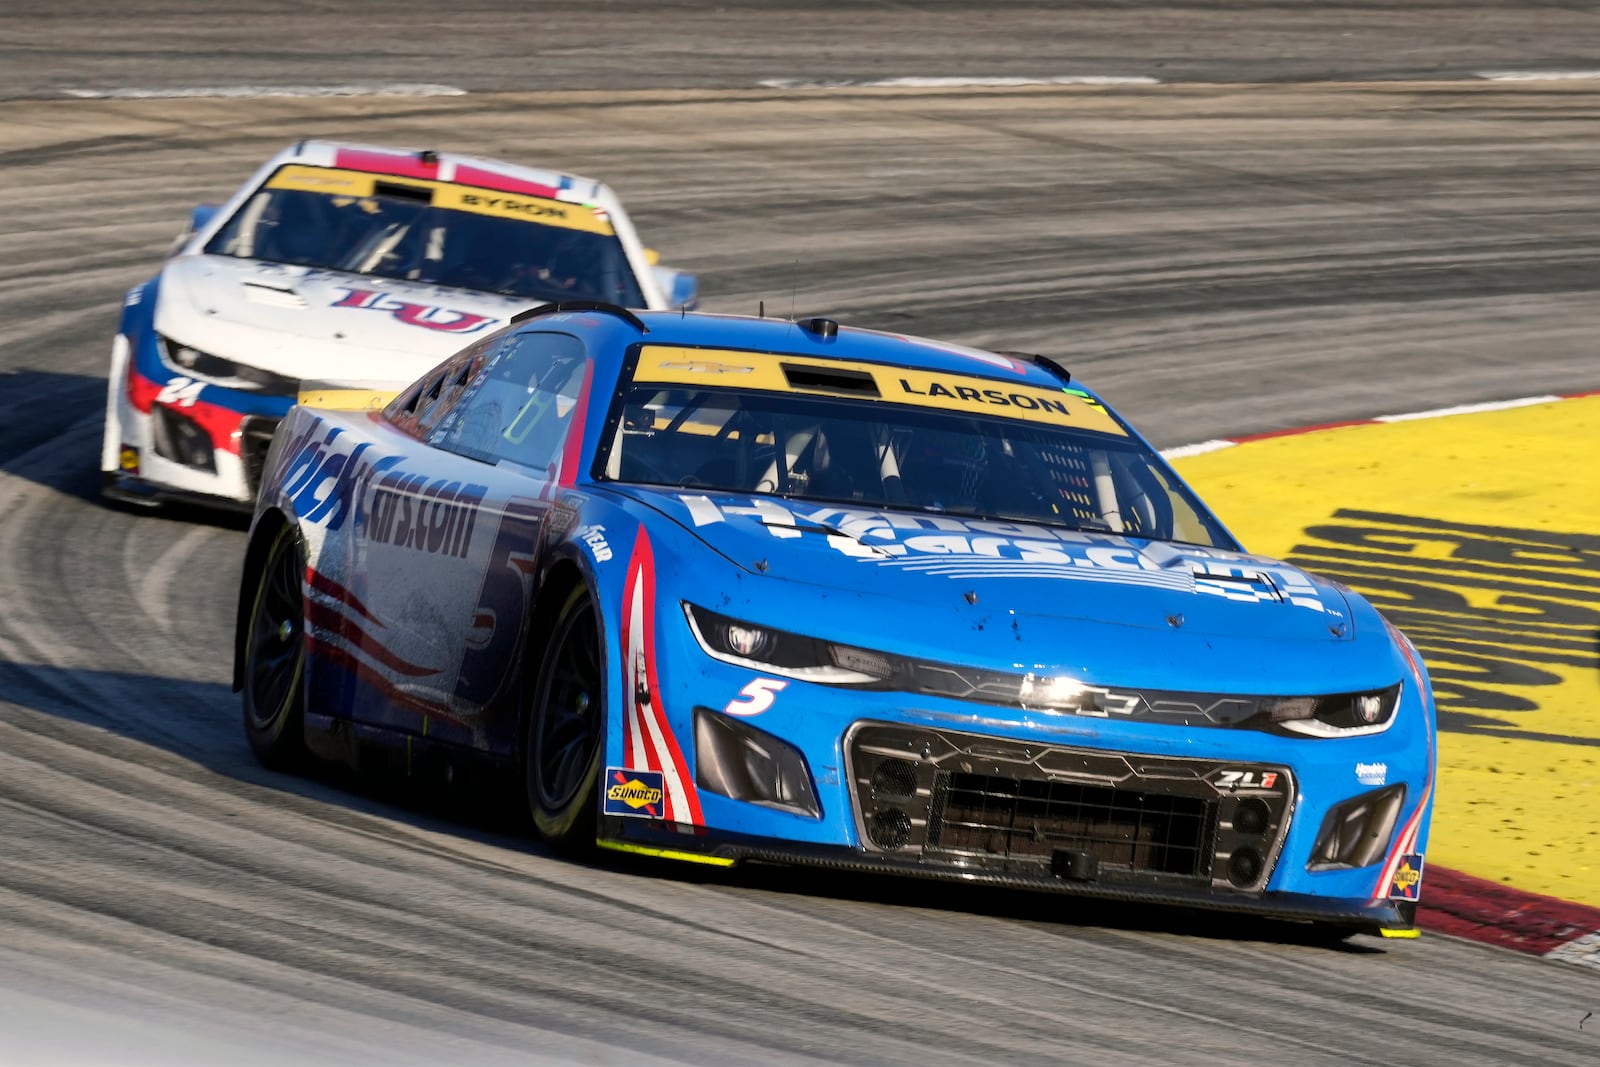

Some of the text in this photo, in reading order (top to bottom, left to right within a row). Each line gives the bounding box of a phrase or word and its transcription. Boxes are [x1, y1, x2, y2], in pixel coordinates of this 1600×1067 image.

[461, 194, 568, 219] BYRON
[157, 377, 208, 408] 24
[899, 378, 1071, 416] LARSON
[723, 677, 790, 717] 5
[610, 784, 663, 803] SUNOCO
[1214, 770, 1278, 789] ZL1
